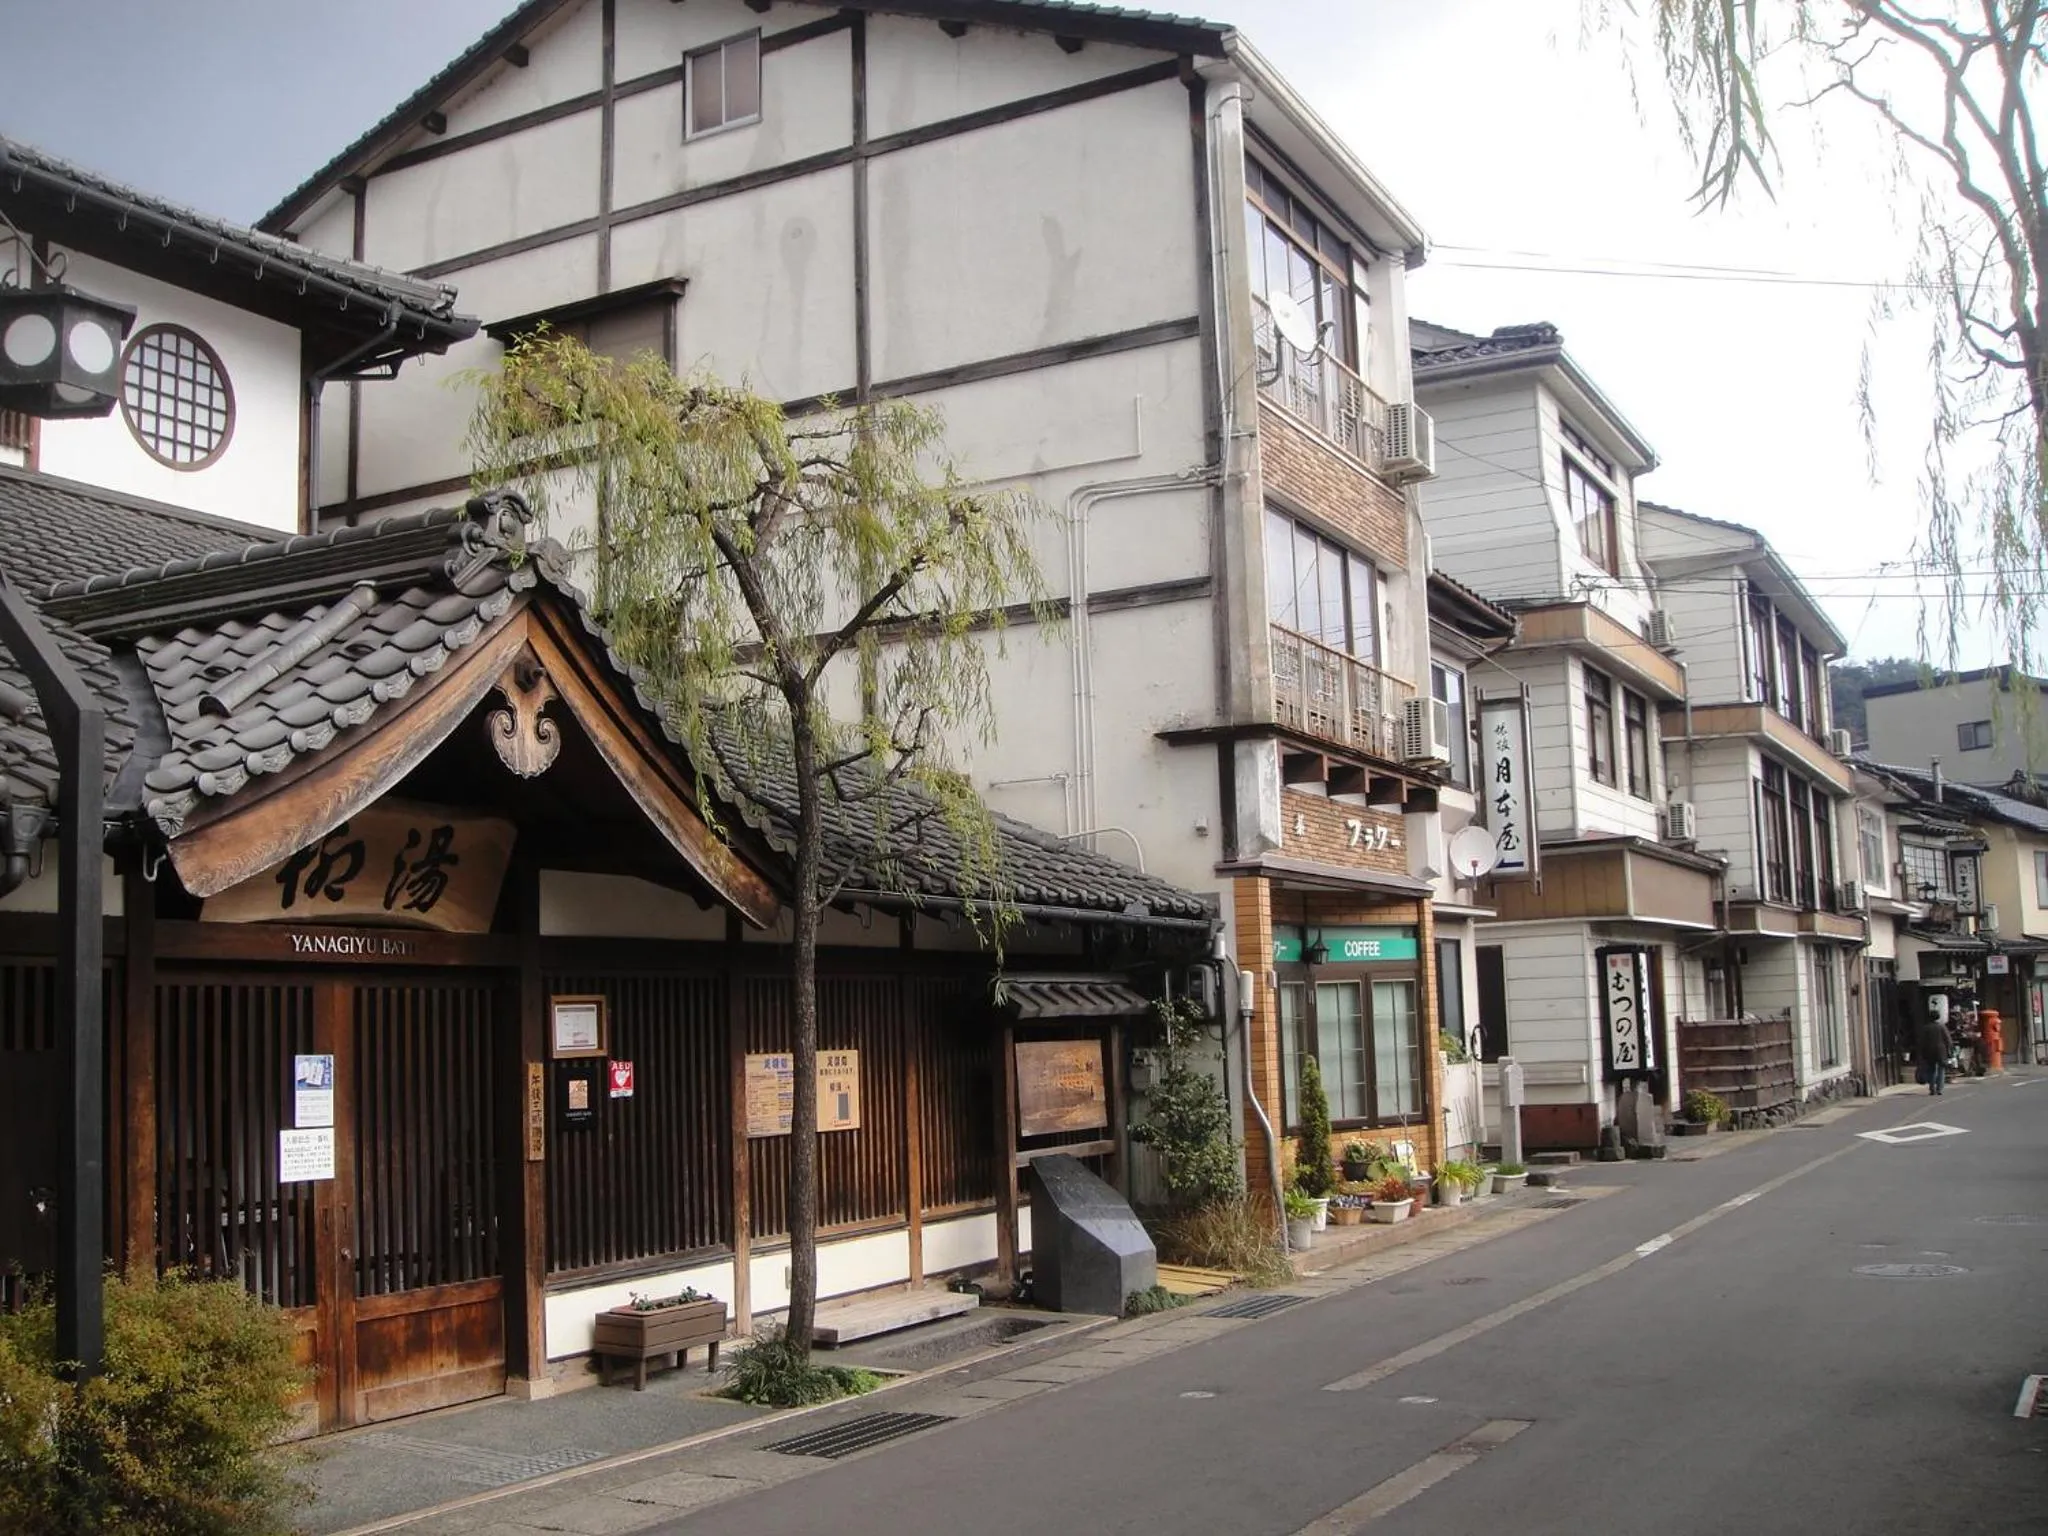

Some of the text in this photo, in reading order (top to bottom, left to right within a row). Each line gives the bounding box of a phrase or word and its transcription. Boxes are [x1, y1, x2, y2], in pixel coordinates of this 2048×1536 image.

[1346, 818, 1401, 850] フラワー
[292, 934, 377, 954] YANAGIYU
[1344, 940, 1381, 957] COFFEE
[1612, 971, 1636, 1065] むつの屋
[612, 1061, 631, 1071] AED
